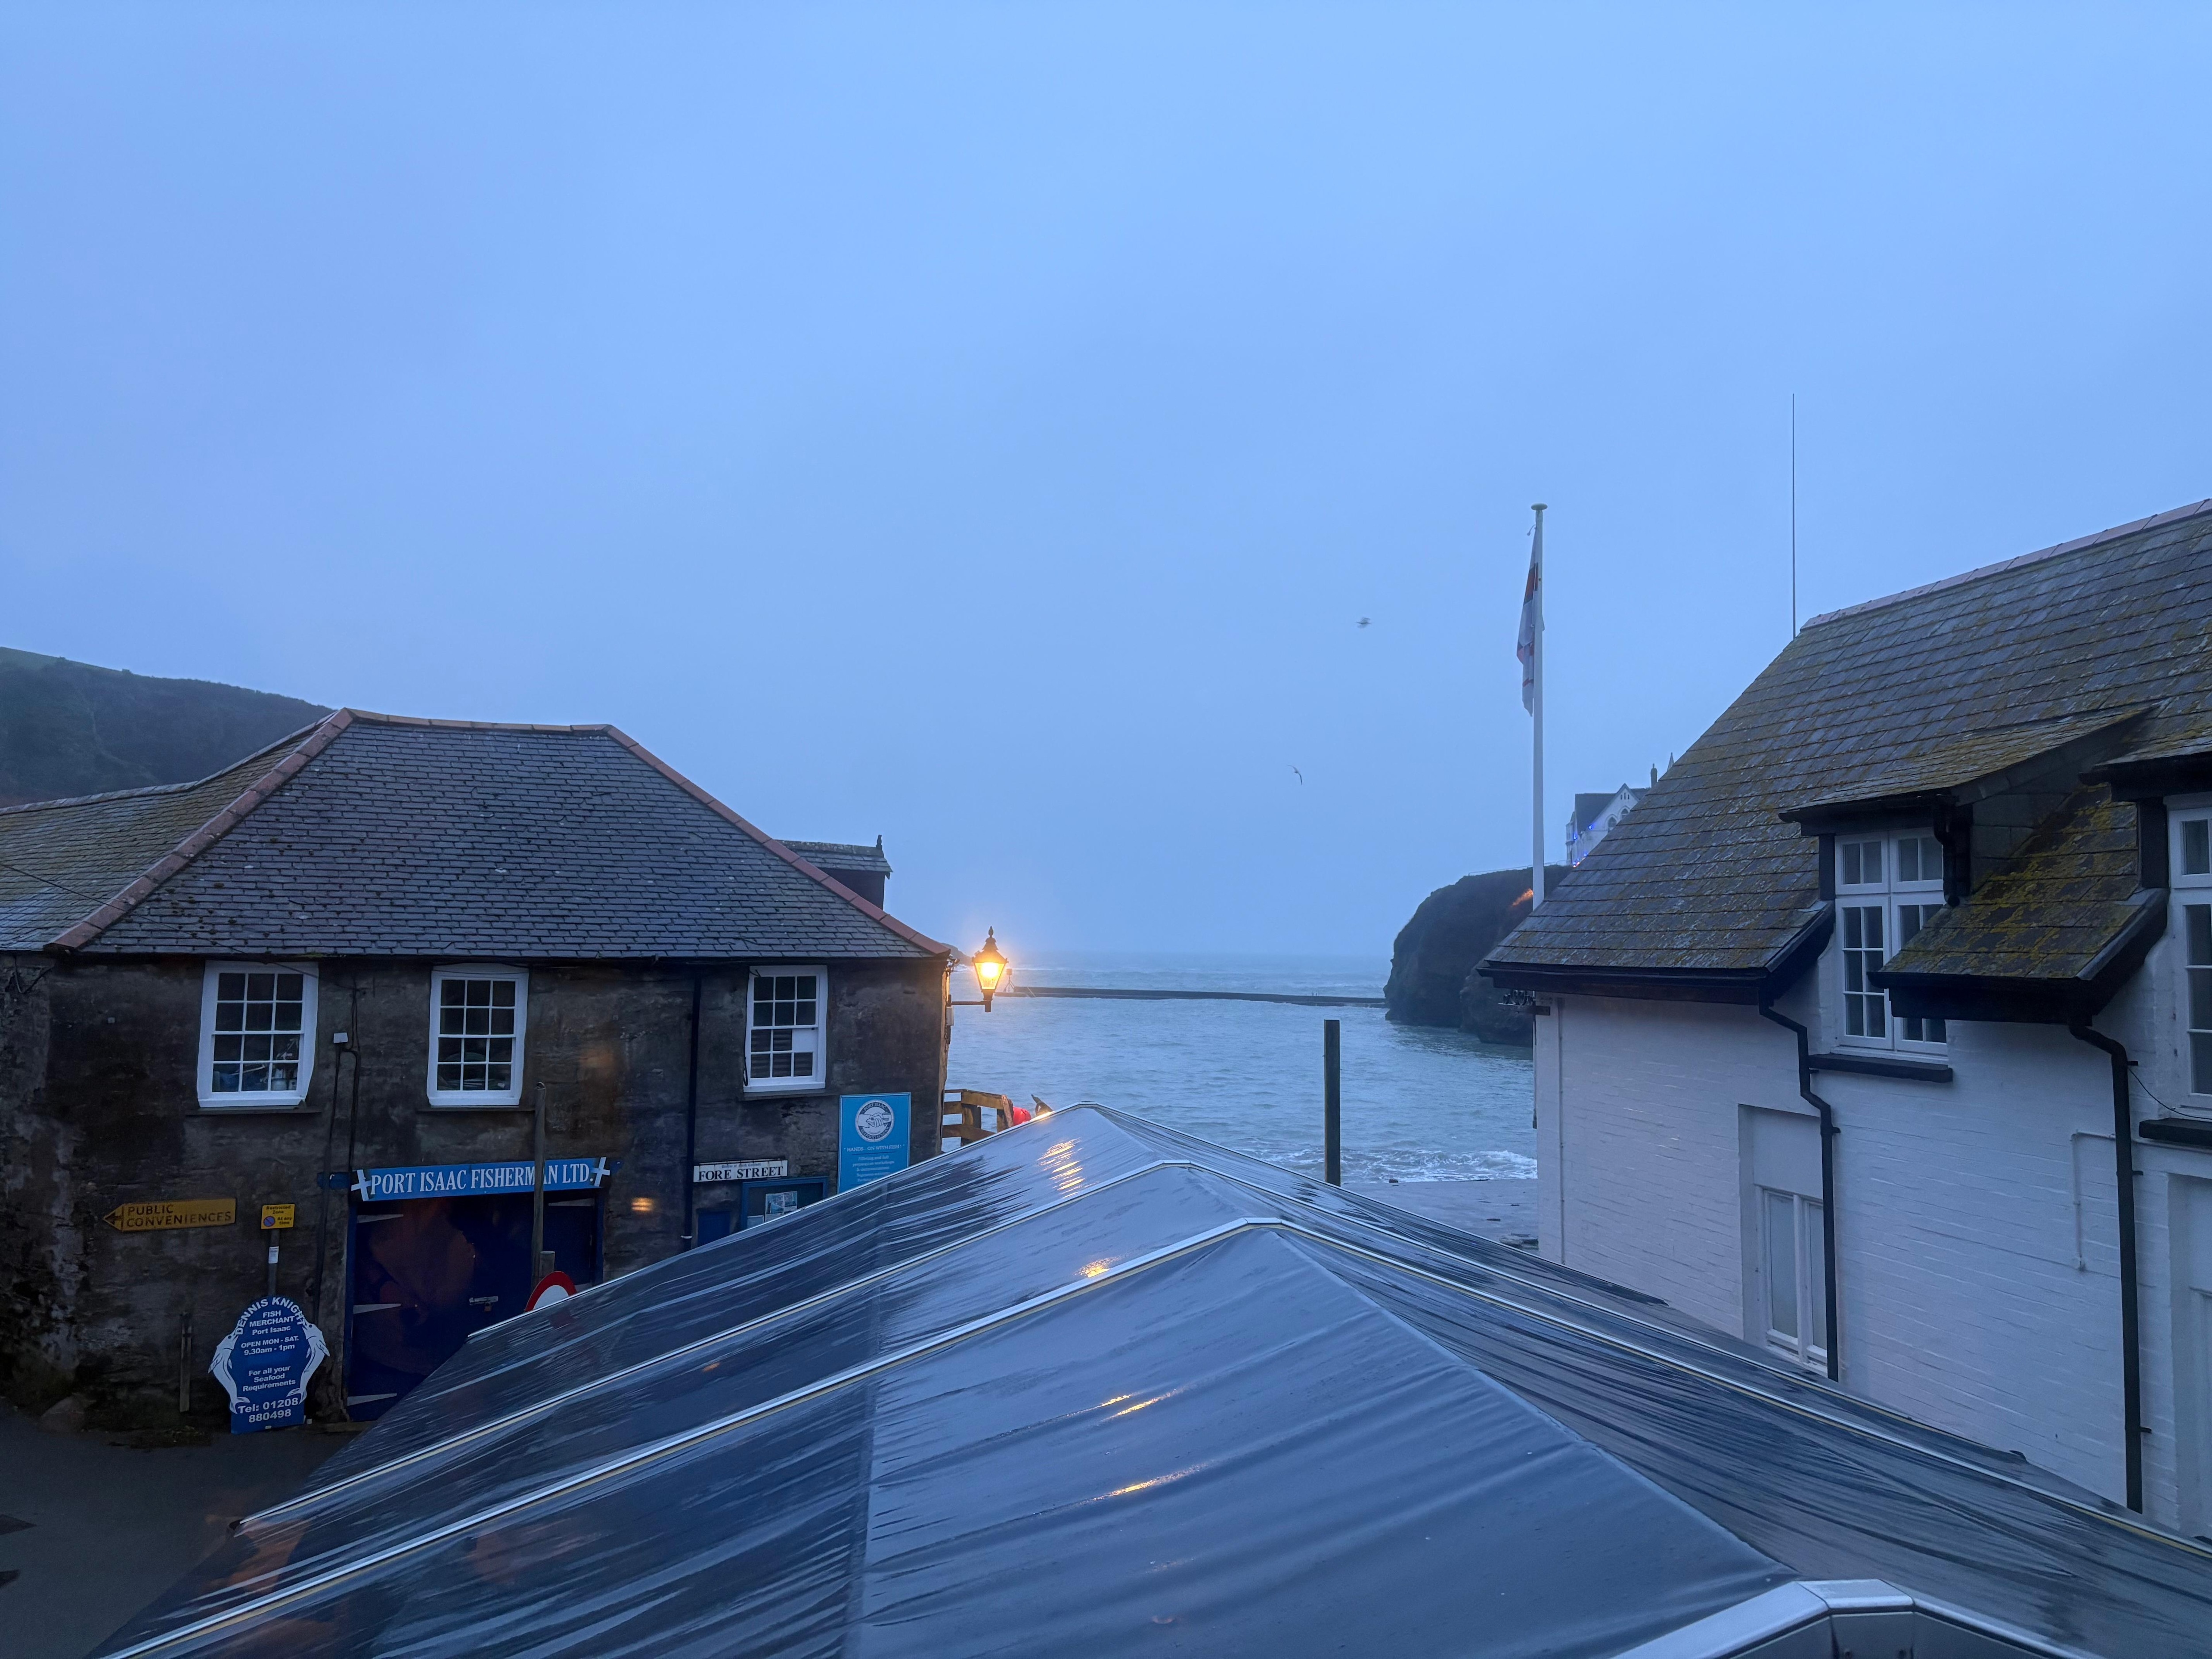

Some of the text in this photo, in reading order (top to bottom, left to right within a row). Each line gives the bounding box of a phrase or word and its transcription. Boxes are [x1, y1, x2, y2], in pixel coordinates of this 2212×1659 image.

[370, 1172, 416, 1195] PORT
[419, 1170, 467, 1192] ISAAC
[562, 1163, 593, 1184] LTD.
[698, 1166, 783, 1181] FORE STREET
[128, 1204, 174, 1216] PUBLIC
[127, 1211, 232, 1228] CONVENIENCES
[235, 1297, 306, 1335] DENNIS KNIGHT
[262, 1310, 281, 1318] FISH
[249, 1316, 295, 1328] MERCHANT
[244, 1347, 273, 1356] 9.30am
[253, 1373, 285, 1383] Seafood
[243, 1379, 296, 1392] Requirements
[238, 1397, 298, 1414] Tel: 01208
[248, 1409, 292, 1423] 880498
